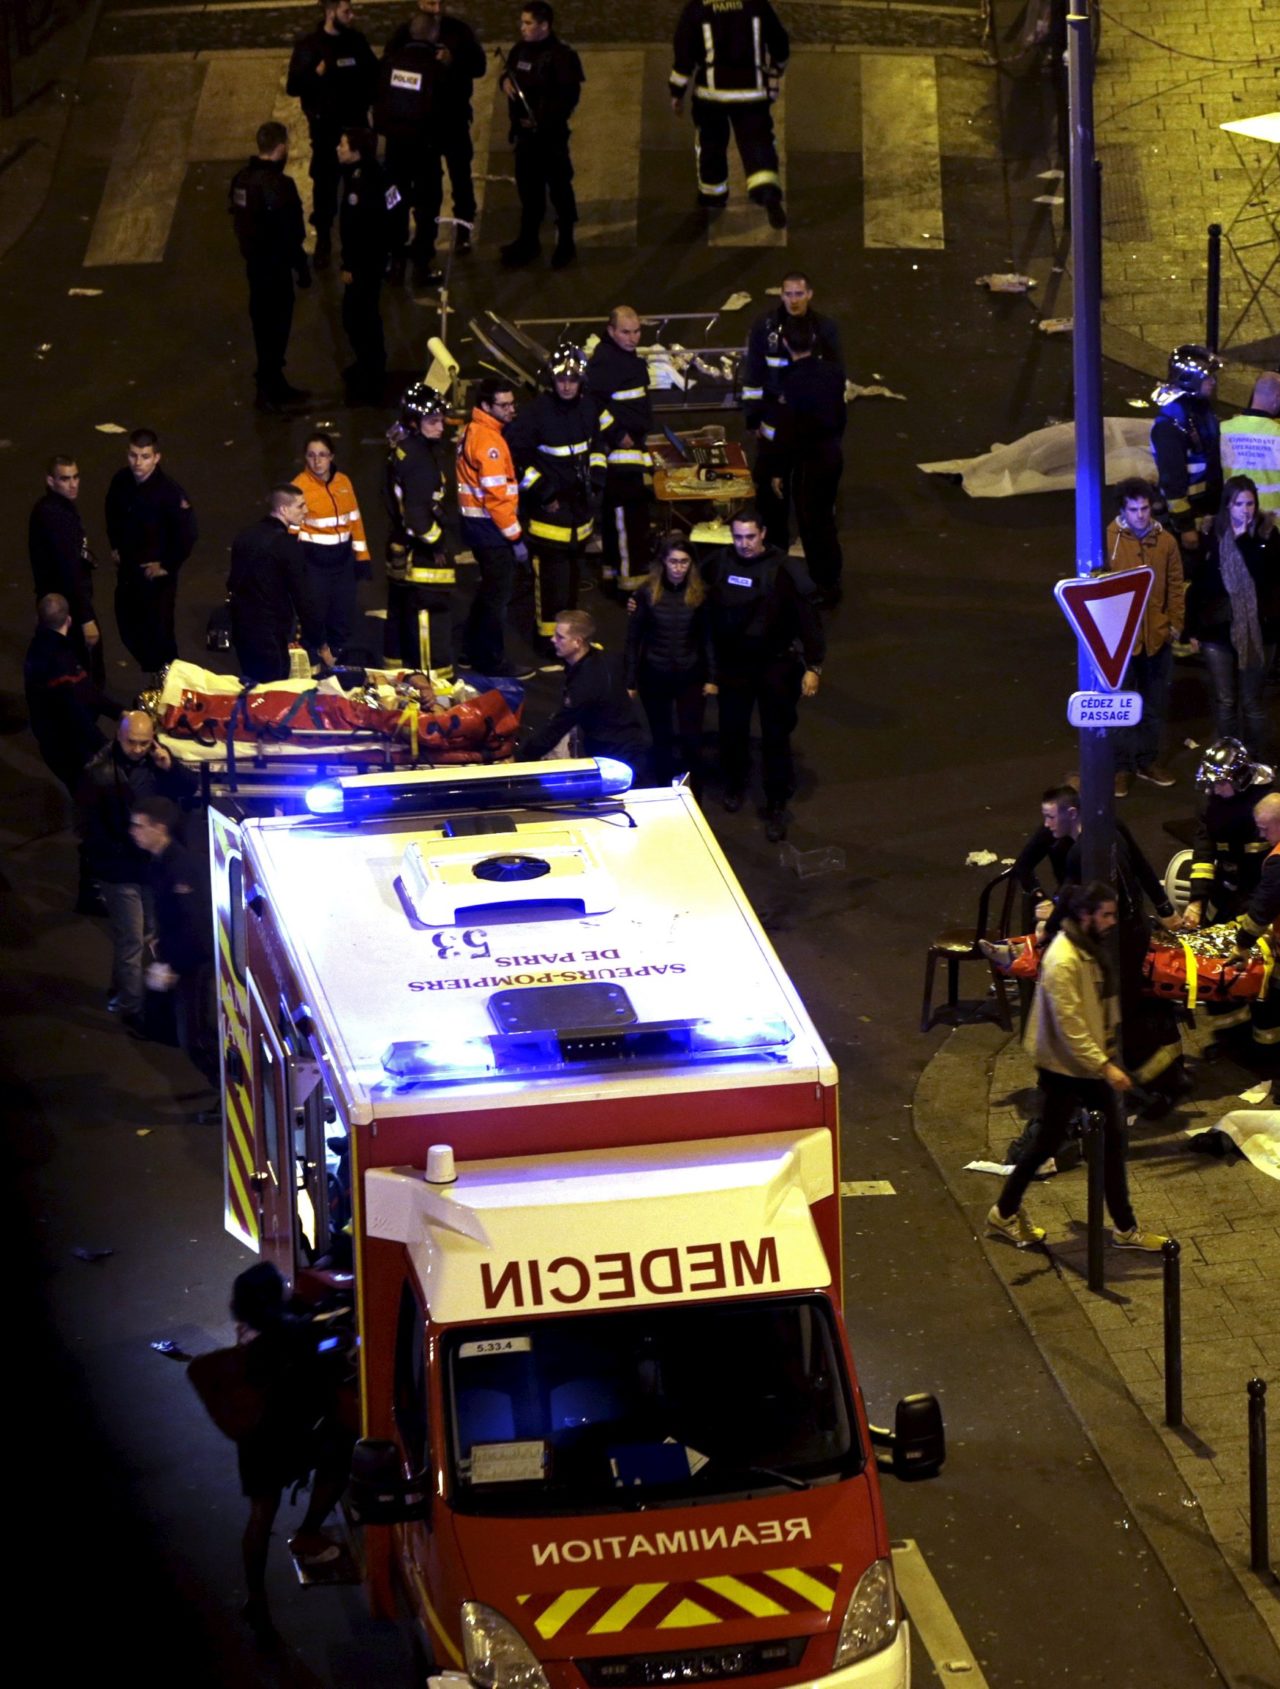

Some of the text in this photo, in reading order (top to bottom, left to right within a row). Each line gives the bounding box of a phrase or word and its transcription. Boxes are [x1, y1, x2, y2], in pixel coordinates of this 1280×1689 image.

[393, 74, 418, 85] POLICE
[1080, 697, 1133, 709] CÉDEZ LE
[1080, 710, 1131, 721] PASSAGE
[431, 928, 491, 960] 53
[494, 948, 621, 967] DE PARIS
[408, 962, 687, 993] SAPEURS-POMPIERS
[477, 1341, 512, 1353] 5.33.4
